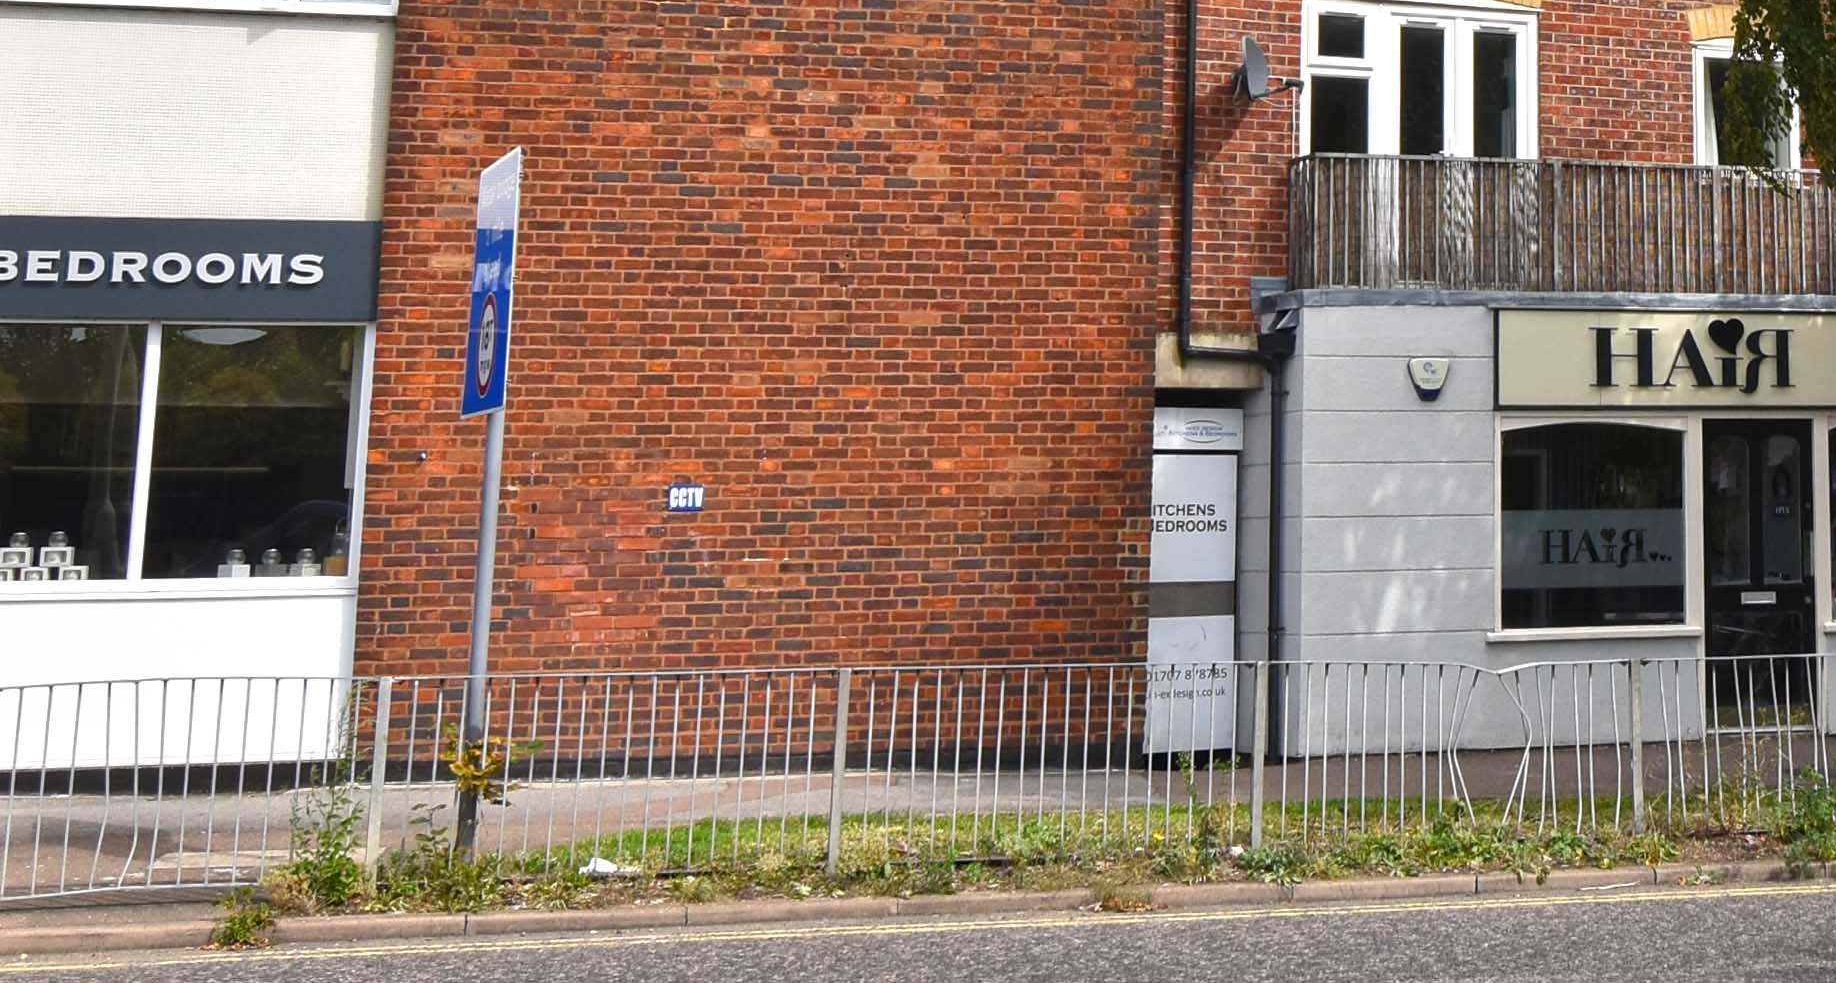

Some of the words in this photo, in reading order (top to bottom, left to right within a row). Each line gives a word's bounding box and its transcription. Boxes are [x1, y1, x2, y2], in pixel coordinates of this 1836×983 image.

[670, 487, 704, 507] CCTV
[1153, 504, 1216, 517] ITCHENS
[1152, 519, 1228, 533] EDROOMS
